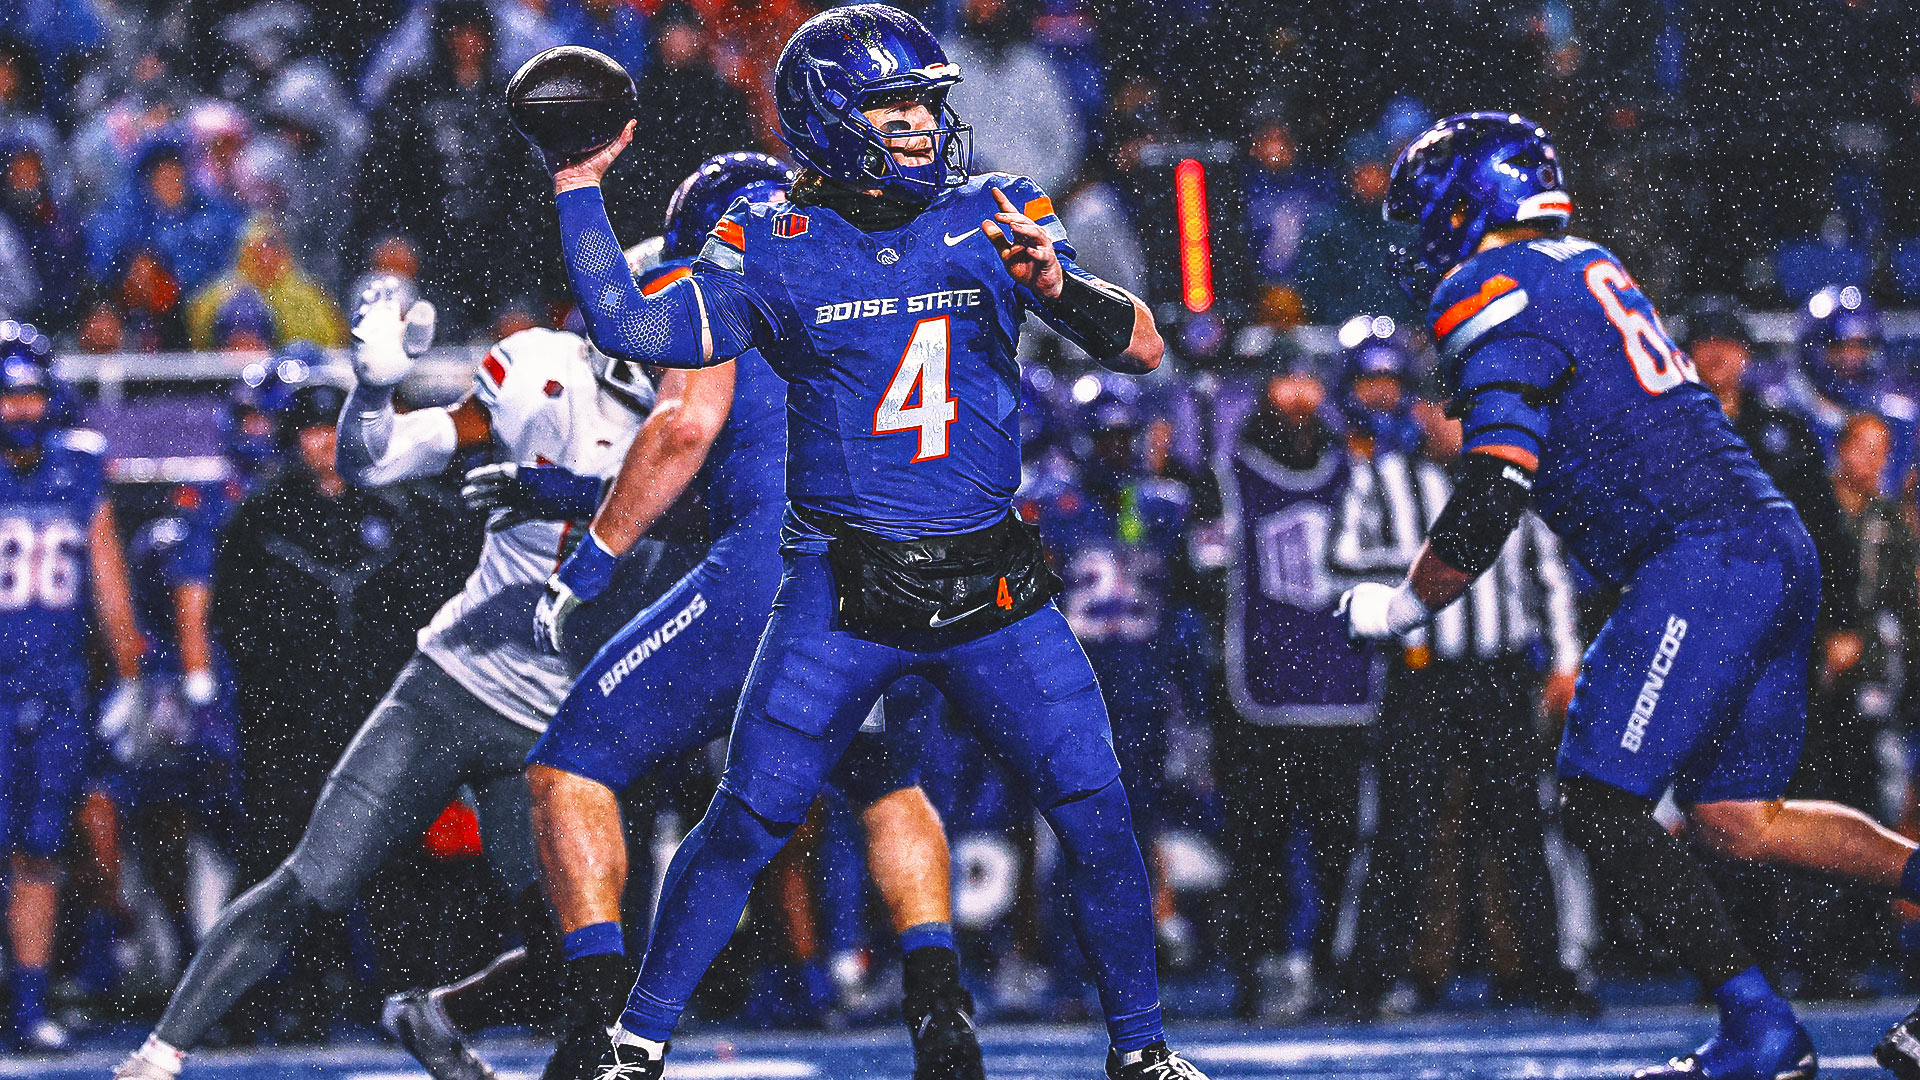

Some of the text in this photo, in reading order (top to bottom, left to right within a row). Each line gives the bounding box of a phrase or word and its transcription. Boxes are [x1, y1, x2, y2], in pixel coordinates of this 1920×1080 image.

[815, 288, 981, 325] BOISE STATE
[872, 314, 958, 464] 4
[0, 515, 79, 608] 86
[996, 576, 1013, 611] 4
[598, 592, 708, 697] BRONCOS
[1620, 613, 1688, 754] BRONCOS
